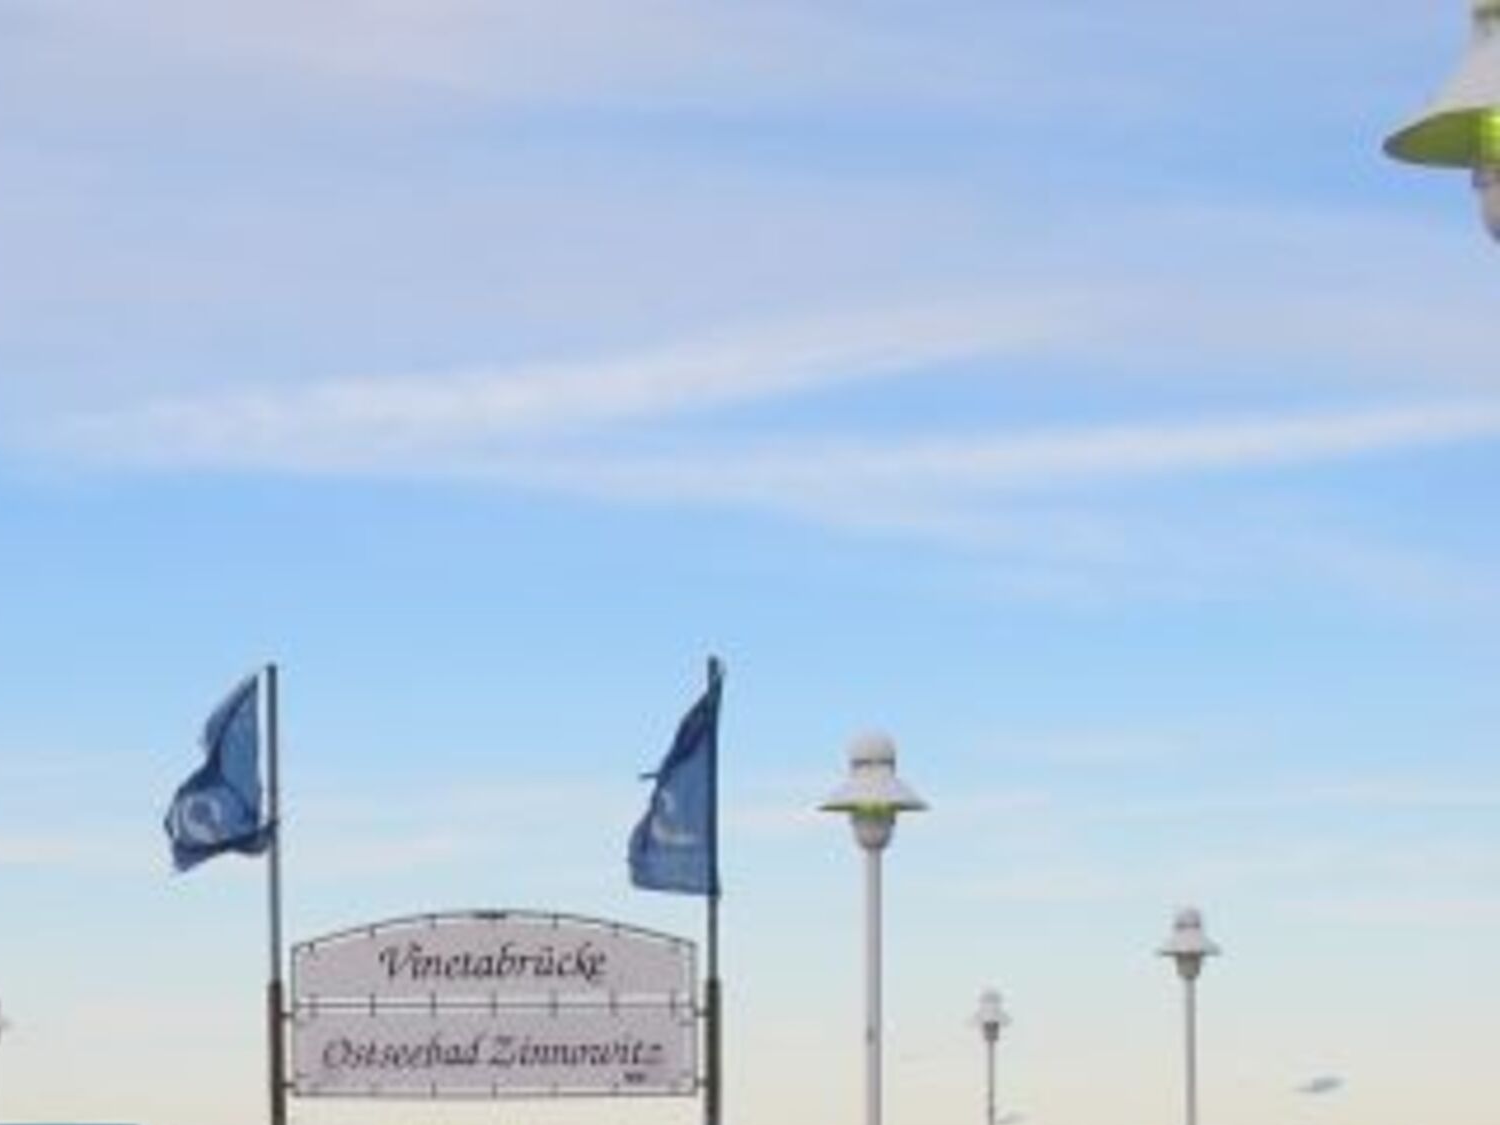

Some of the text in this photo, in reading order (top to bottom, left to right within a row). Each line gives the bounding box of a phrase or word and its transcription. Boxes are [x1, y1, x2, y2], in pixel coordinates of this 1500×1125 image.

[379, 941, 607, 983] Vinetabrücke
[321, 1031, 665, 1070] Ostseebad Zinnowitz
